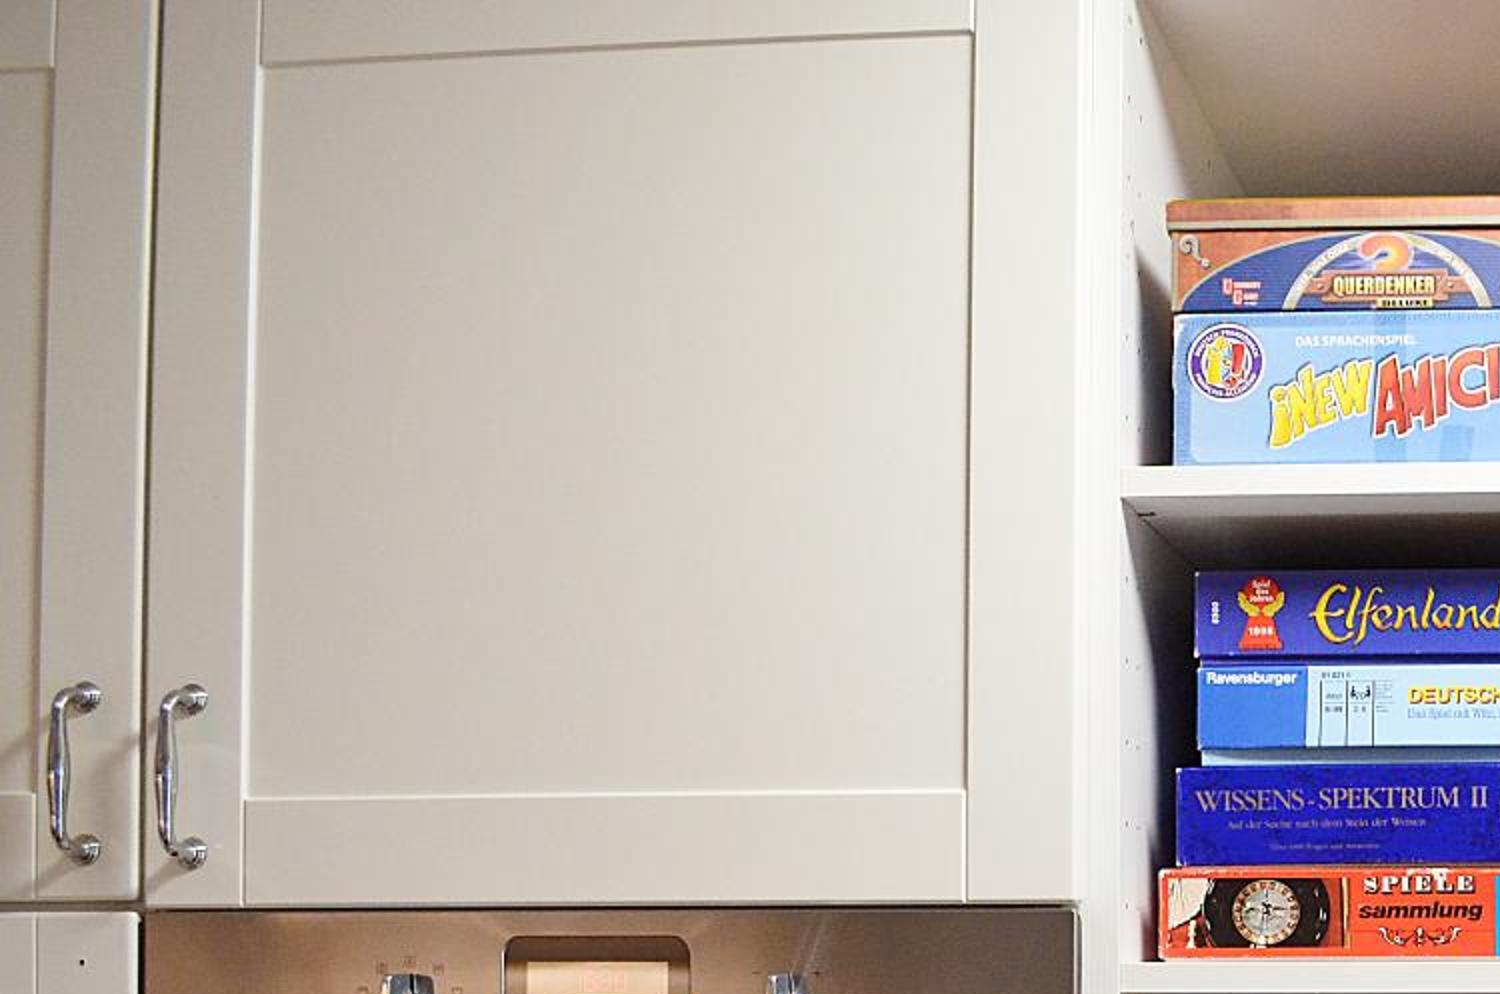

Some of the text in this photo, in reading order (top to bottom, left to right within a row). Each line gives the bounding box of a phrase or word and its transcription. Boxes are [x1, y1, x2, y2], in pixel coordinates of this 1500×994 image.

[1333, 275, 1435, 296] QUERDENKER
[1295, 335, 1318, 347] DAS
[1206, 671, 1298, 687] Ravensburger
[1470, 785, 1488, 808] II
[1363, 874, 1475, 894] SPIELE
[1359, 900, 1483, 921] sammlung
